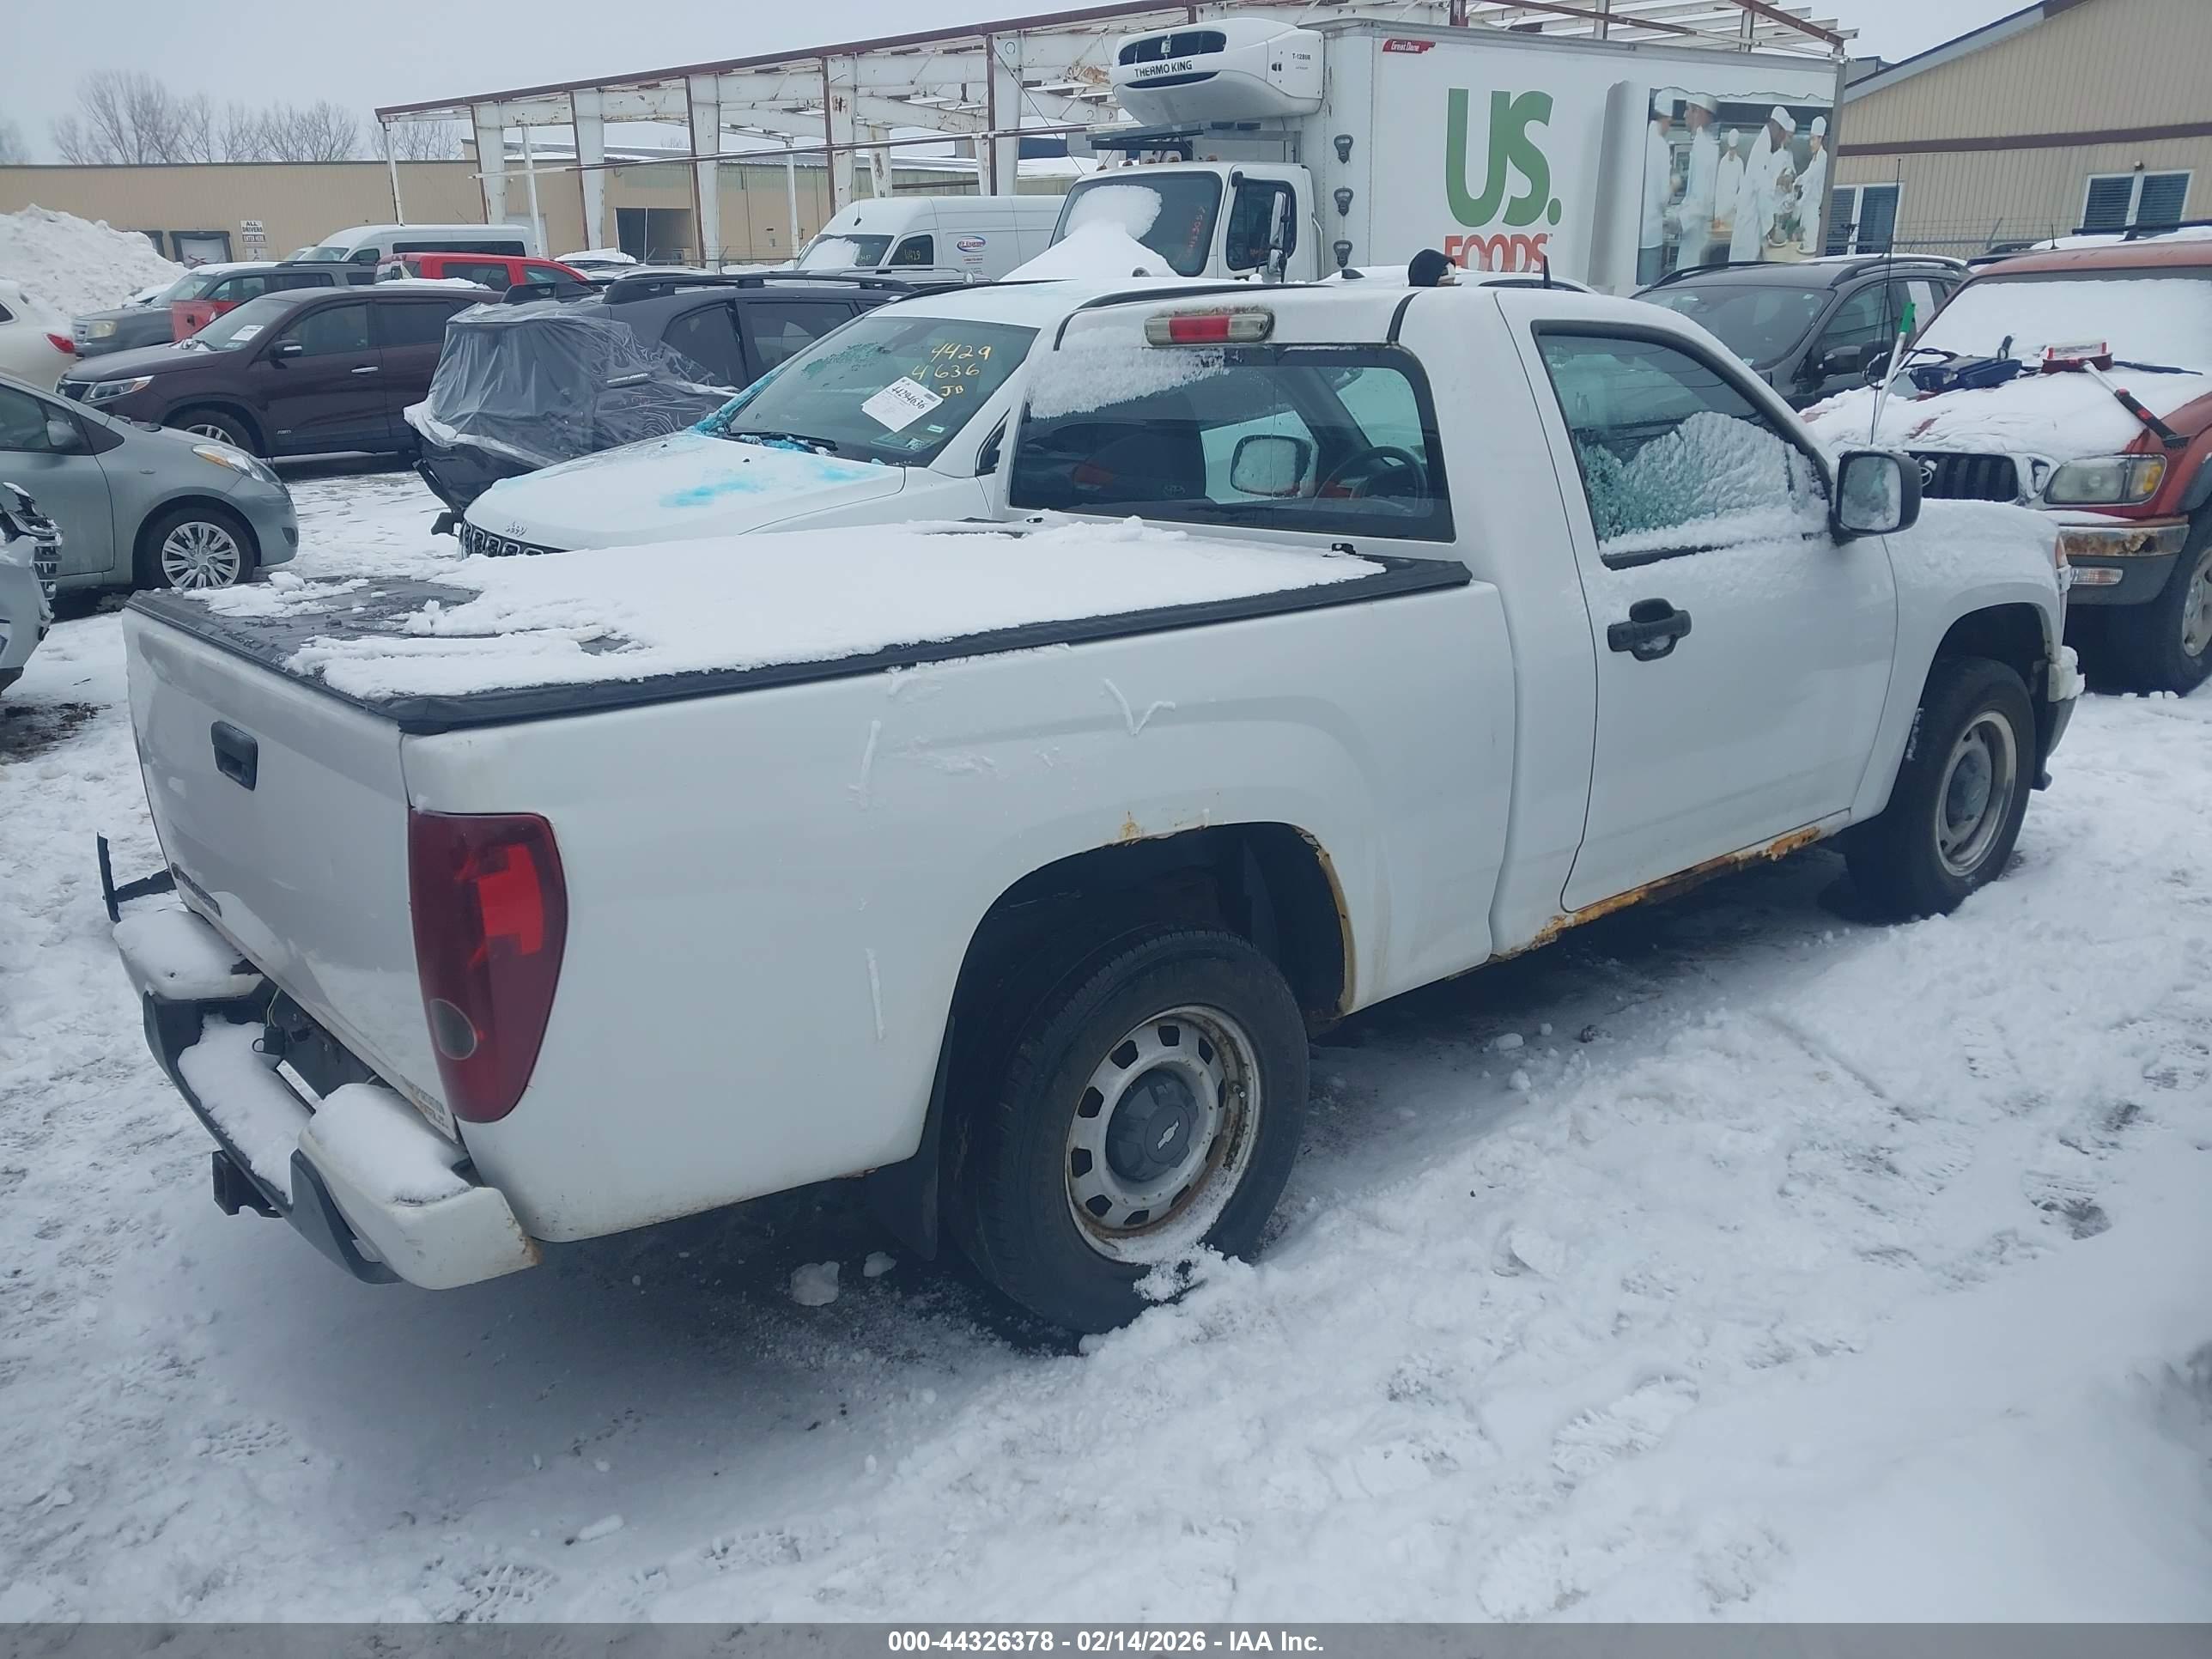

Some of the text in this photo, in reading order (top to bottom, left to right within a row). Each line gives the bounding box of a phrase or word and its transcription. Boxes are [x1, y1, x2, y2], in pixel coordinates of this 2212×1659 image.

[1391, 41, 1420, 52] Great Dane
[1134, 59, 1193, 78] THERMO KING
[1444, 232, 1549, 272] FOODS
[931, 343, 992, 362] 4429
[891, 386, 927, 410] 44294636
[940, 385, 964, 397] JB
